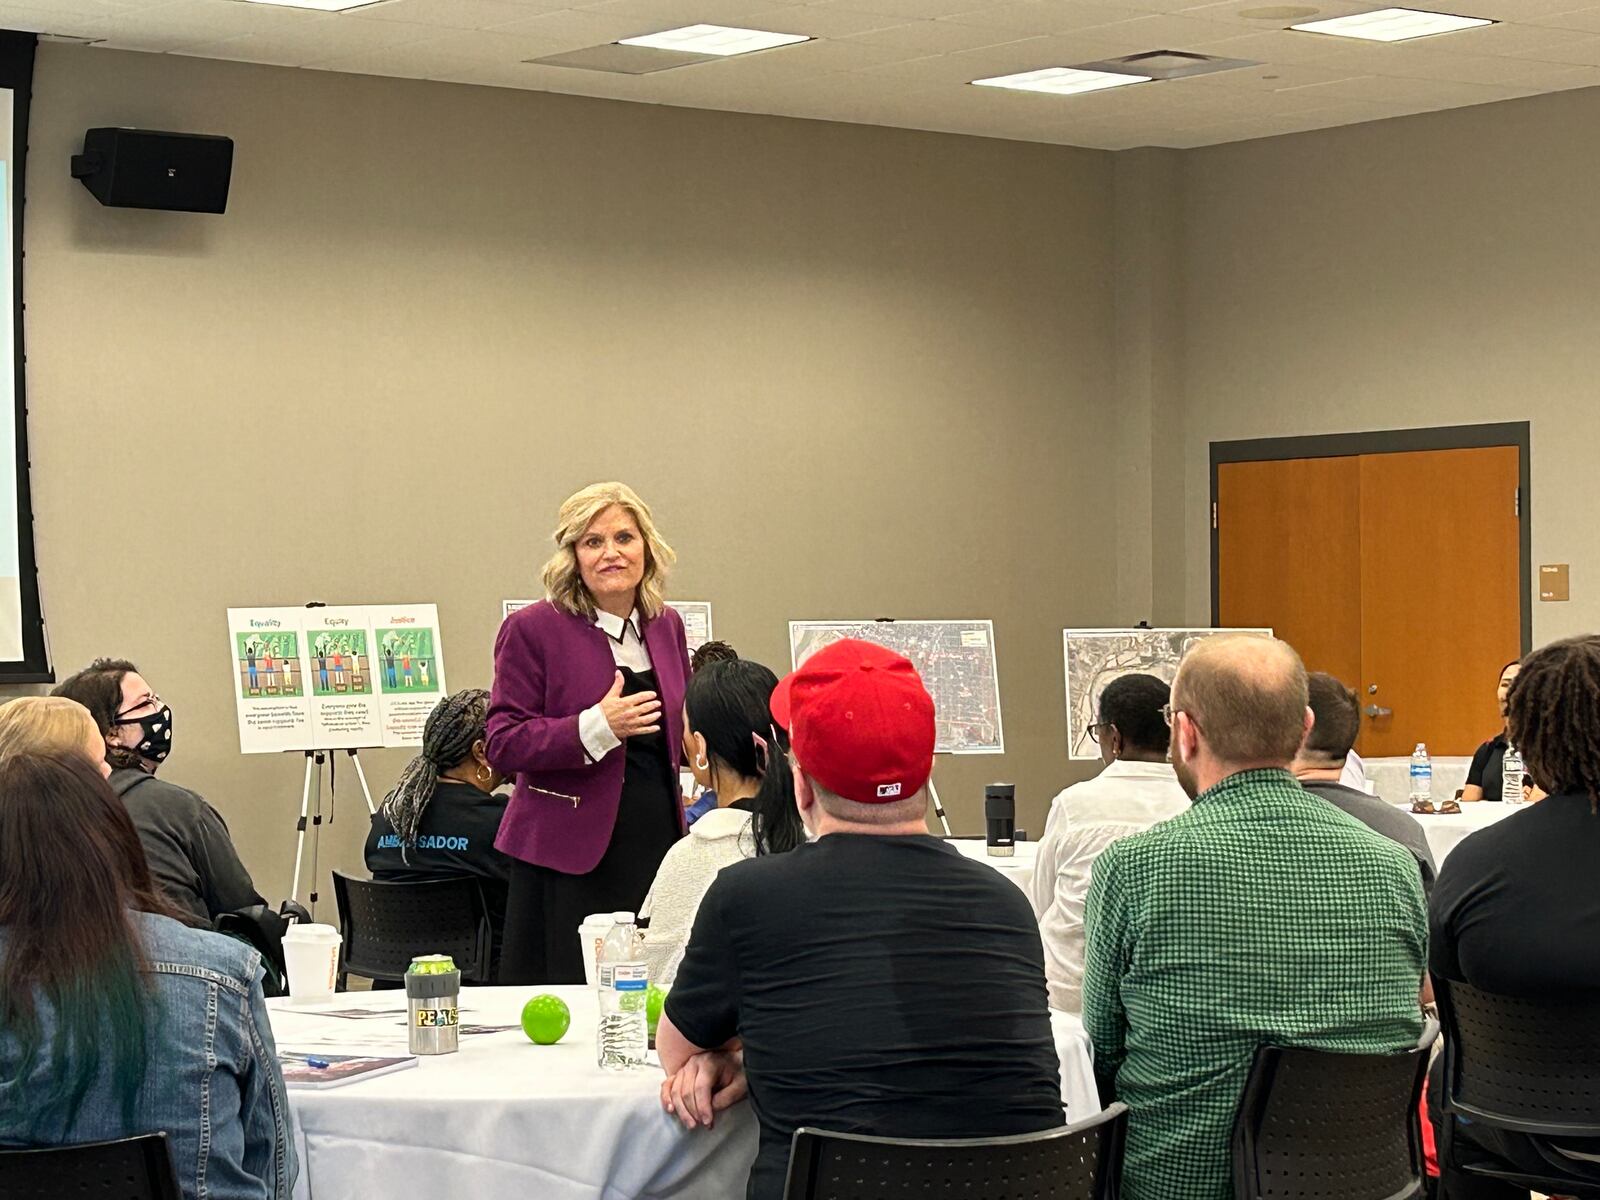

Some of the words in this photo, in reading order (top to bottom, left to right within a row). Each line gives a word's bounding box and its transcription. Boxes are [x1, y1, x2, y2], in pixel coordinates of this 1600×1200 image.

[324, 617, 349, 627] Equity
[377, 834, 469, 851] AMBSADOR
[418, 1009, 458, 1026] PEAC
